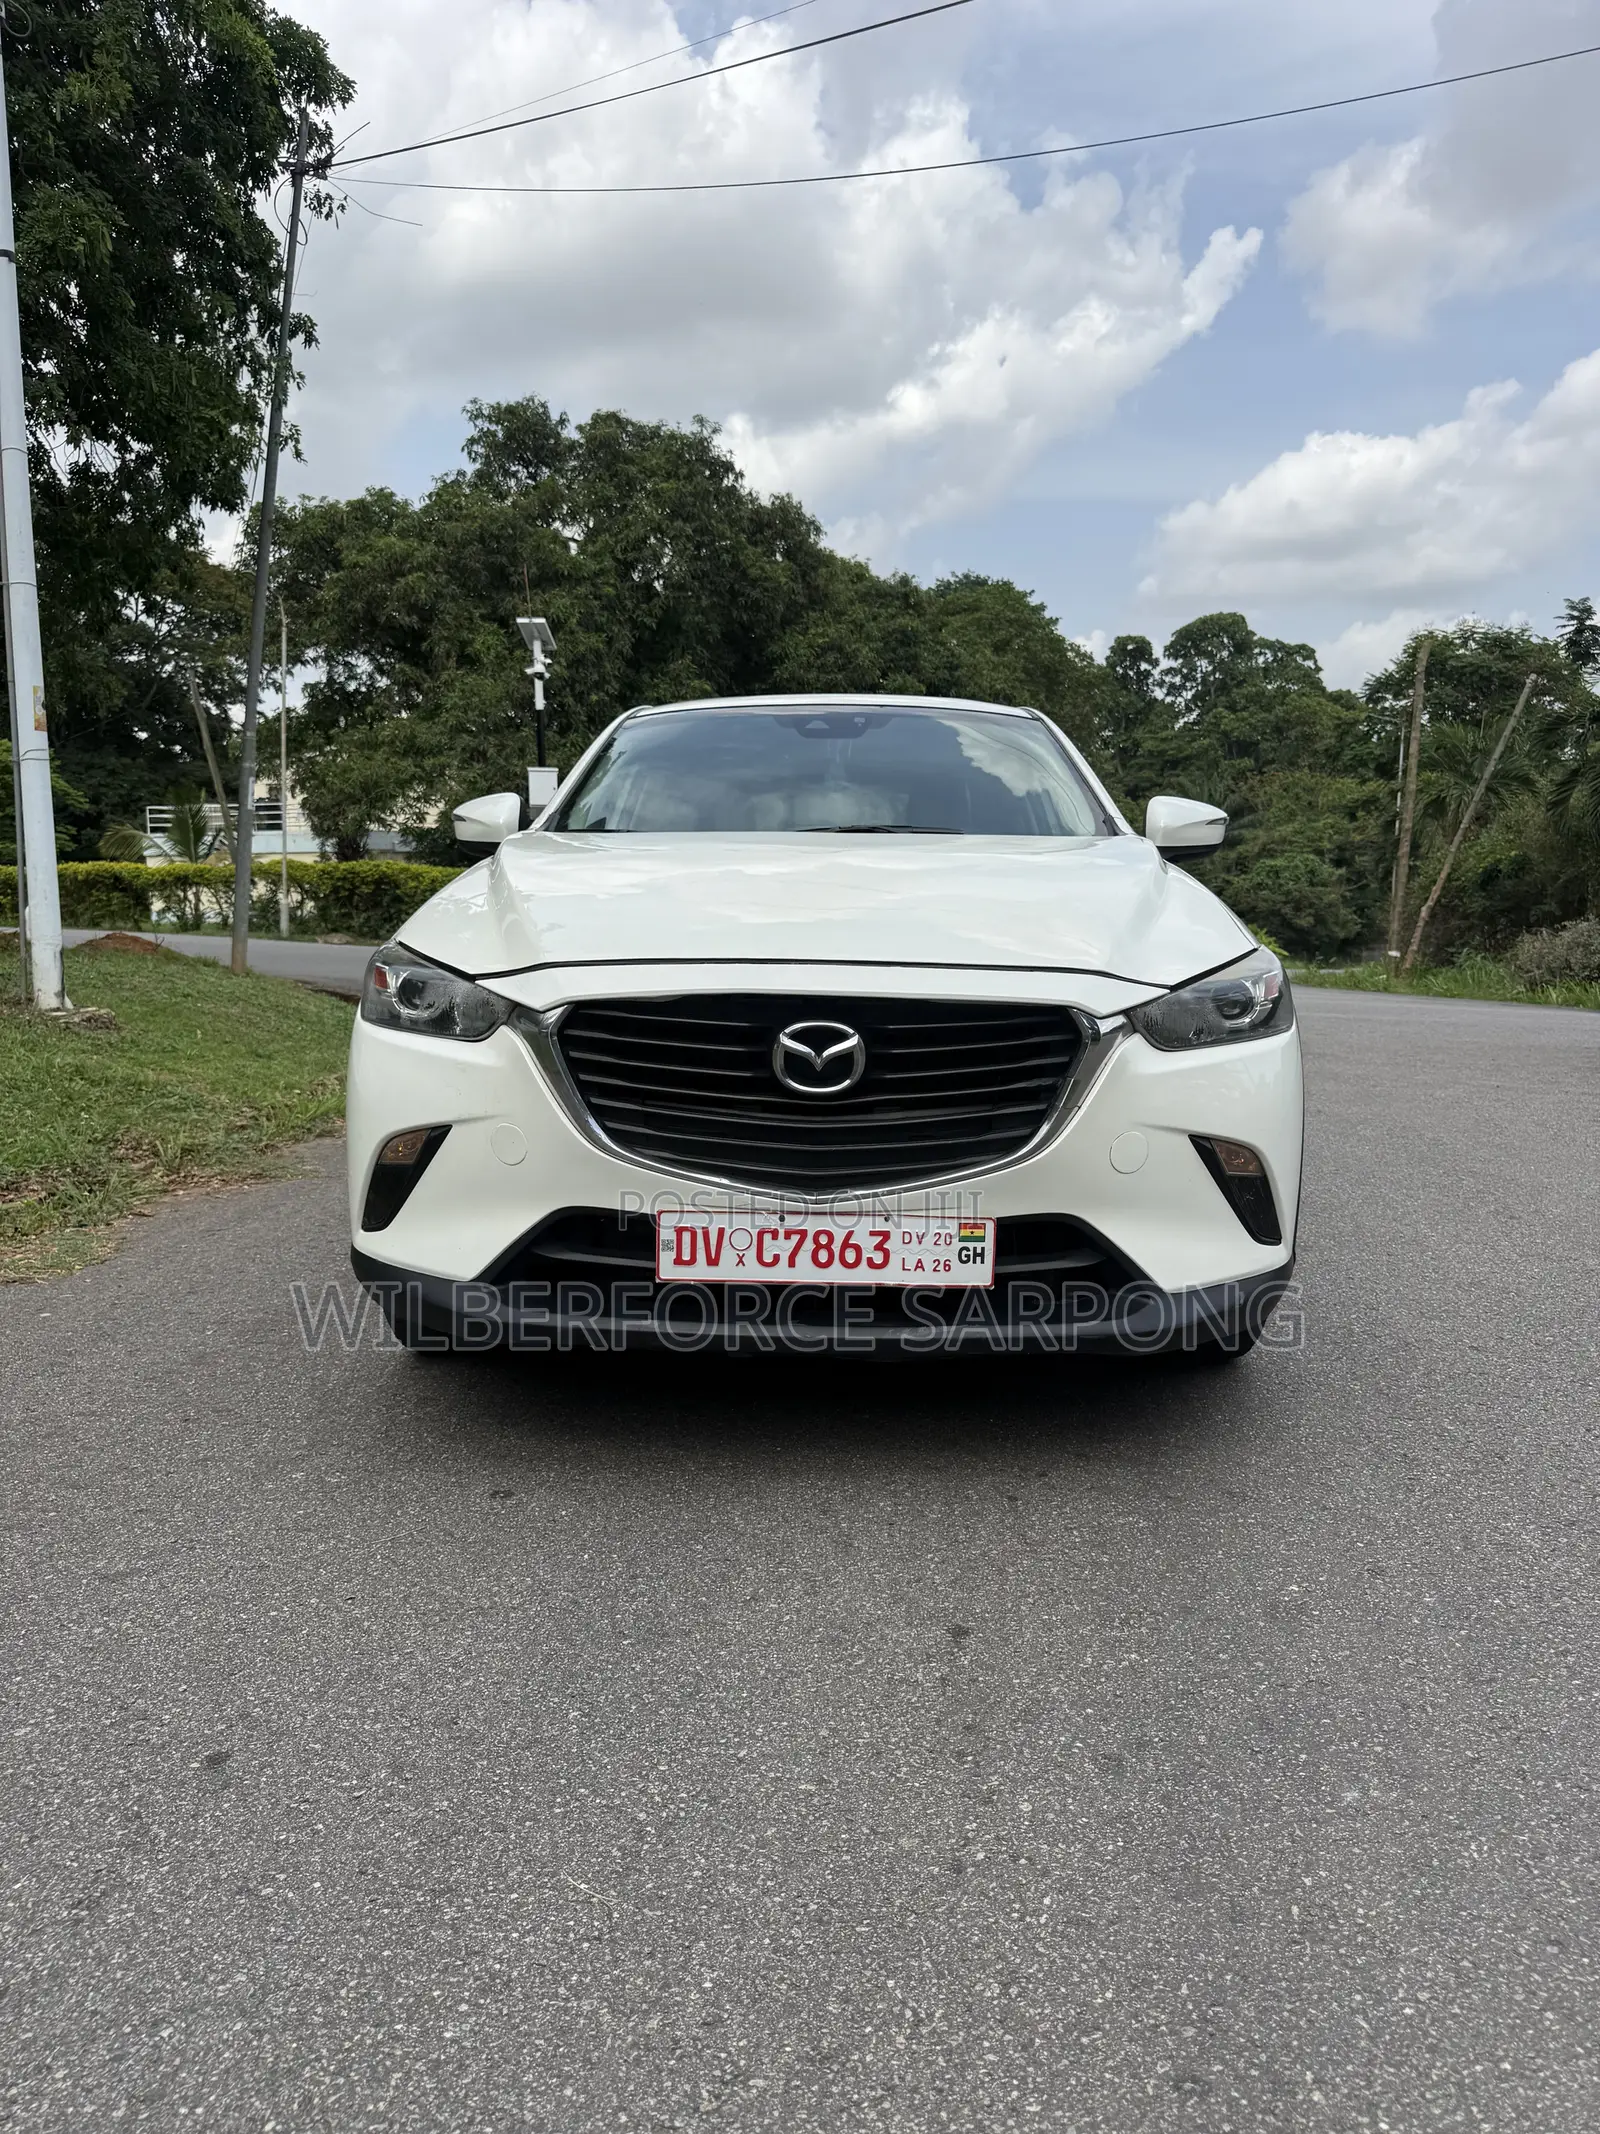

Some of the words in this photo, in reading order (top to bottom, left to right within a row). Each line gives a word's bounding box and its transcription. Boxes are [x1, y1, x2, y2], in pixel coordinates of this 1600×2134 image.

[902, 1231, 926, 1245] DV
[933, 1232, 953, 1246] 20
[673, 1226, 726, 1267] DV
[756, 1228, 891, 1270] C7863
[957, 1246, 986, 1265] GH
[902, 1257, 926, 1272] LA
[932, 1258, 952, 1272] 26
